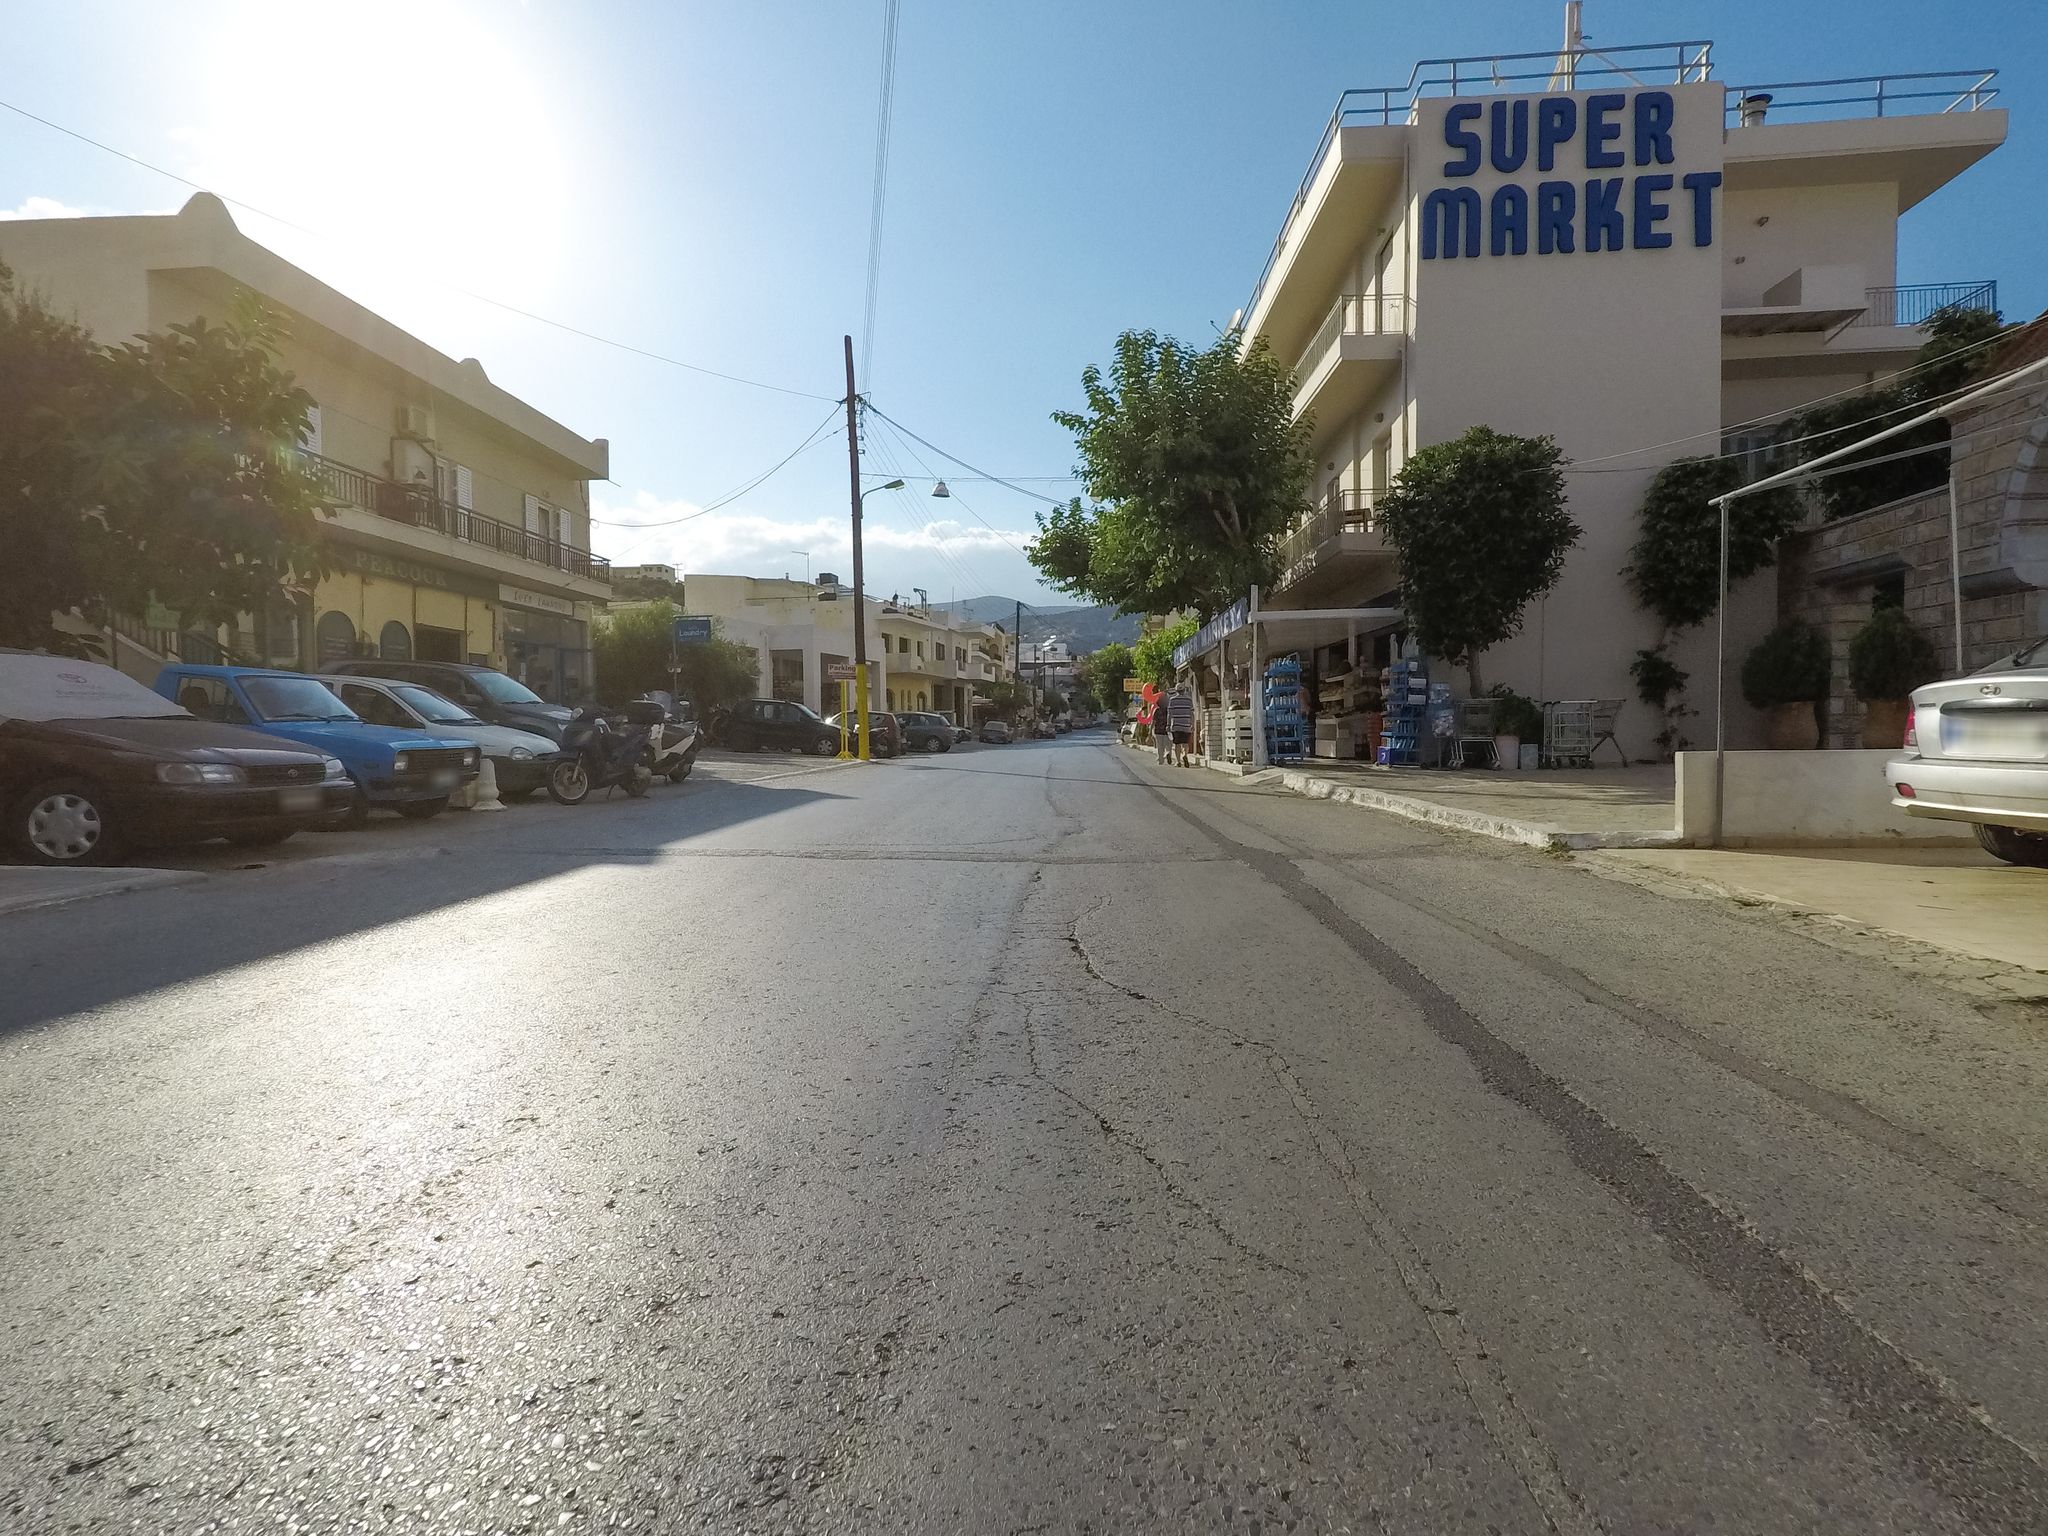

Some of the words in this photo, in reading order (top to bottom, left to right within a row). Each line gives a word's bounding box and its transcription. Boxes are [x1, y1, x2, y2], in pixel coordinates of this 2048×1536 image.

[1444, 91, 1675, 177] SUPER
[1422, 171, 1722, 260] MARKET
[355, 551, 447, 586] PEACOCK
[679, 628, 708, 640] Laundry
[829, 664, 857, 672] Parking
